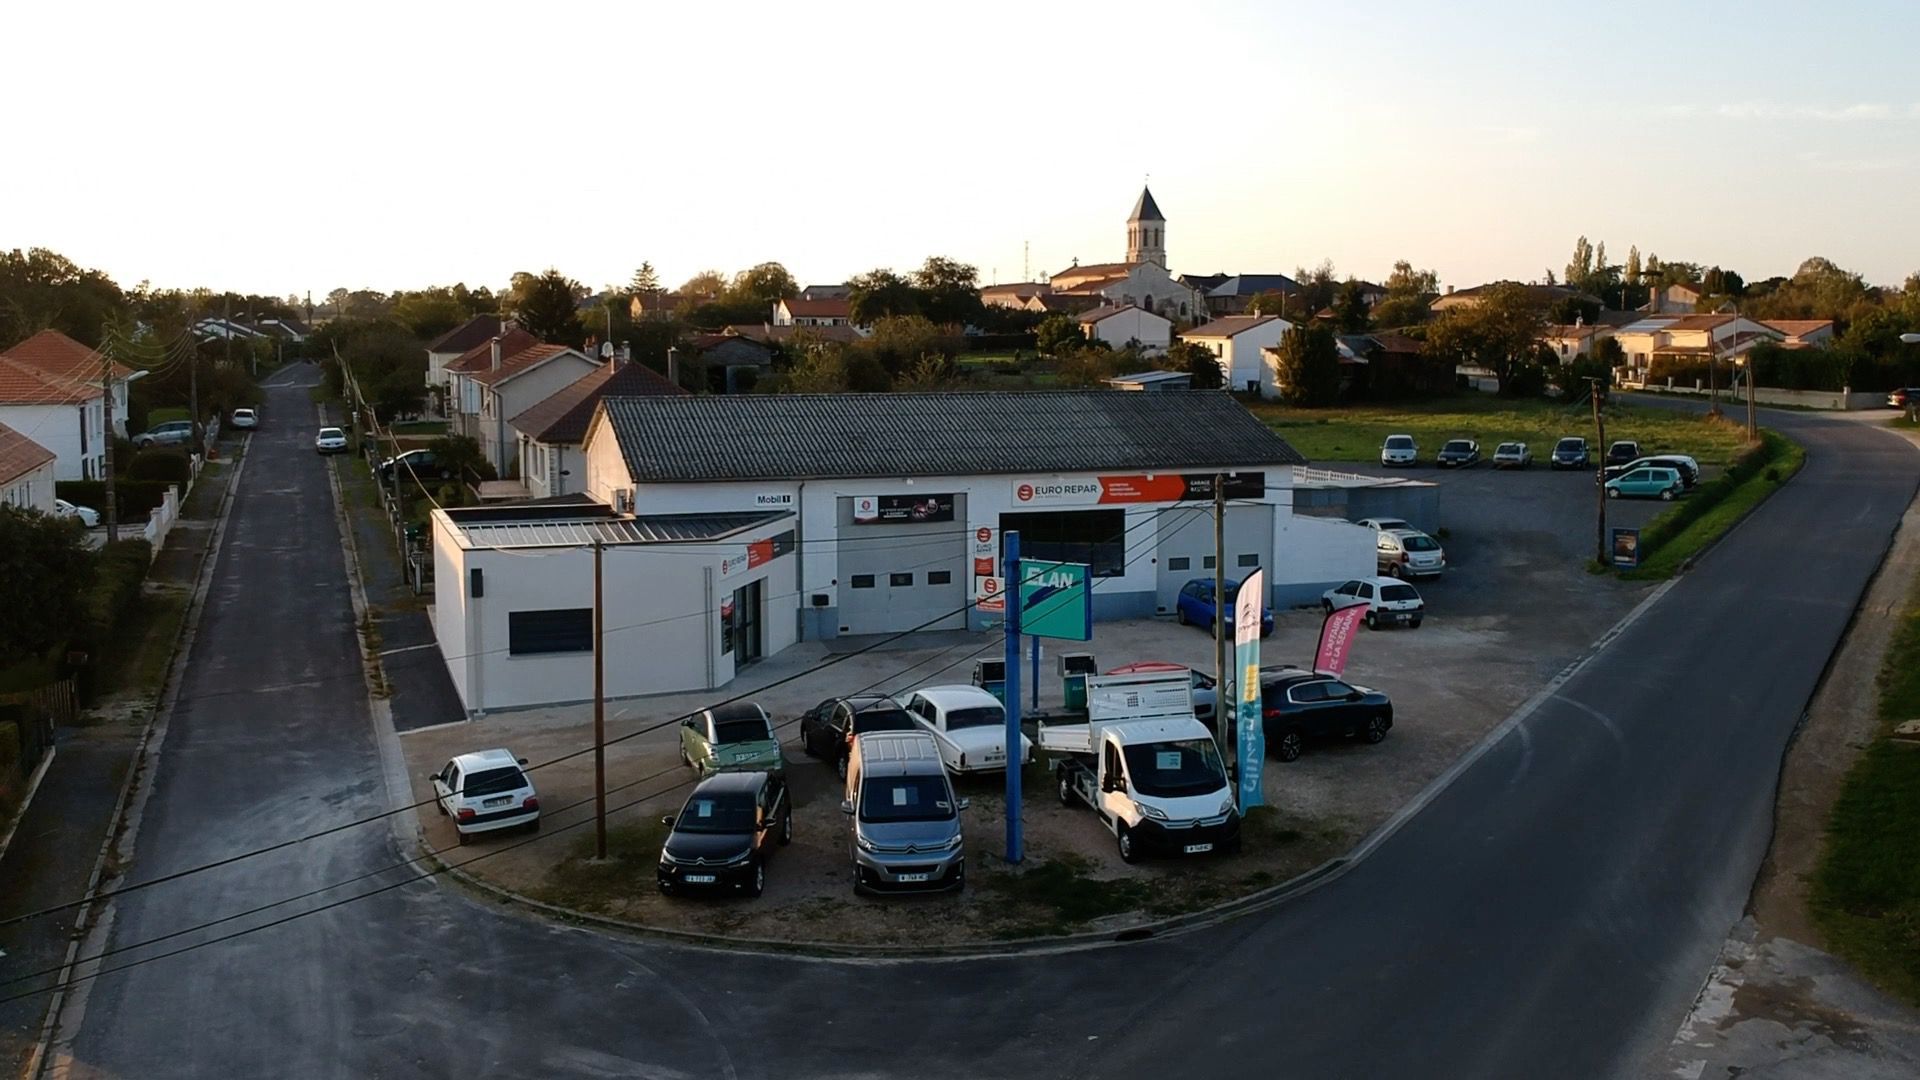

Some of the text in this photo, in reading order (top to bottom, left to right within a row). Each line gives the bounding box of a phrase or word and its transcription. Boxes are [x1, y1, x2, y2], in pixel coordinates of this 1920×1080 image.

[757, 495, 782, 504] Mobil
[1025, 567, 1074, 589] ELAN
[1325, 617, 1344, 656] L'AFFAIRE
[1333, 647, 1342, 658] LA
